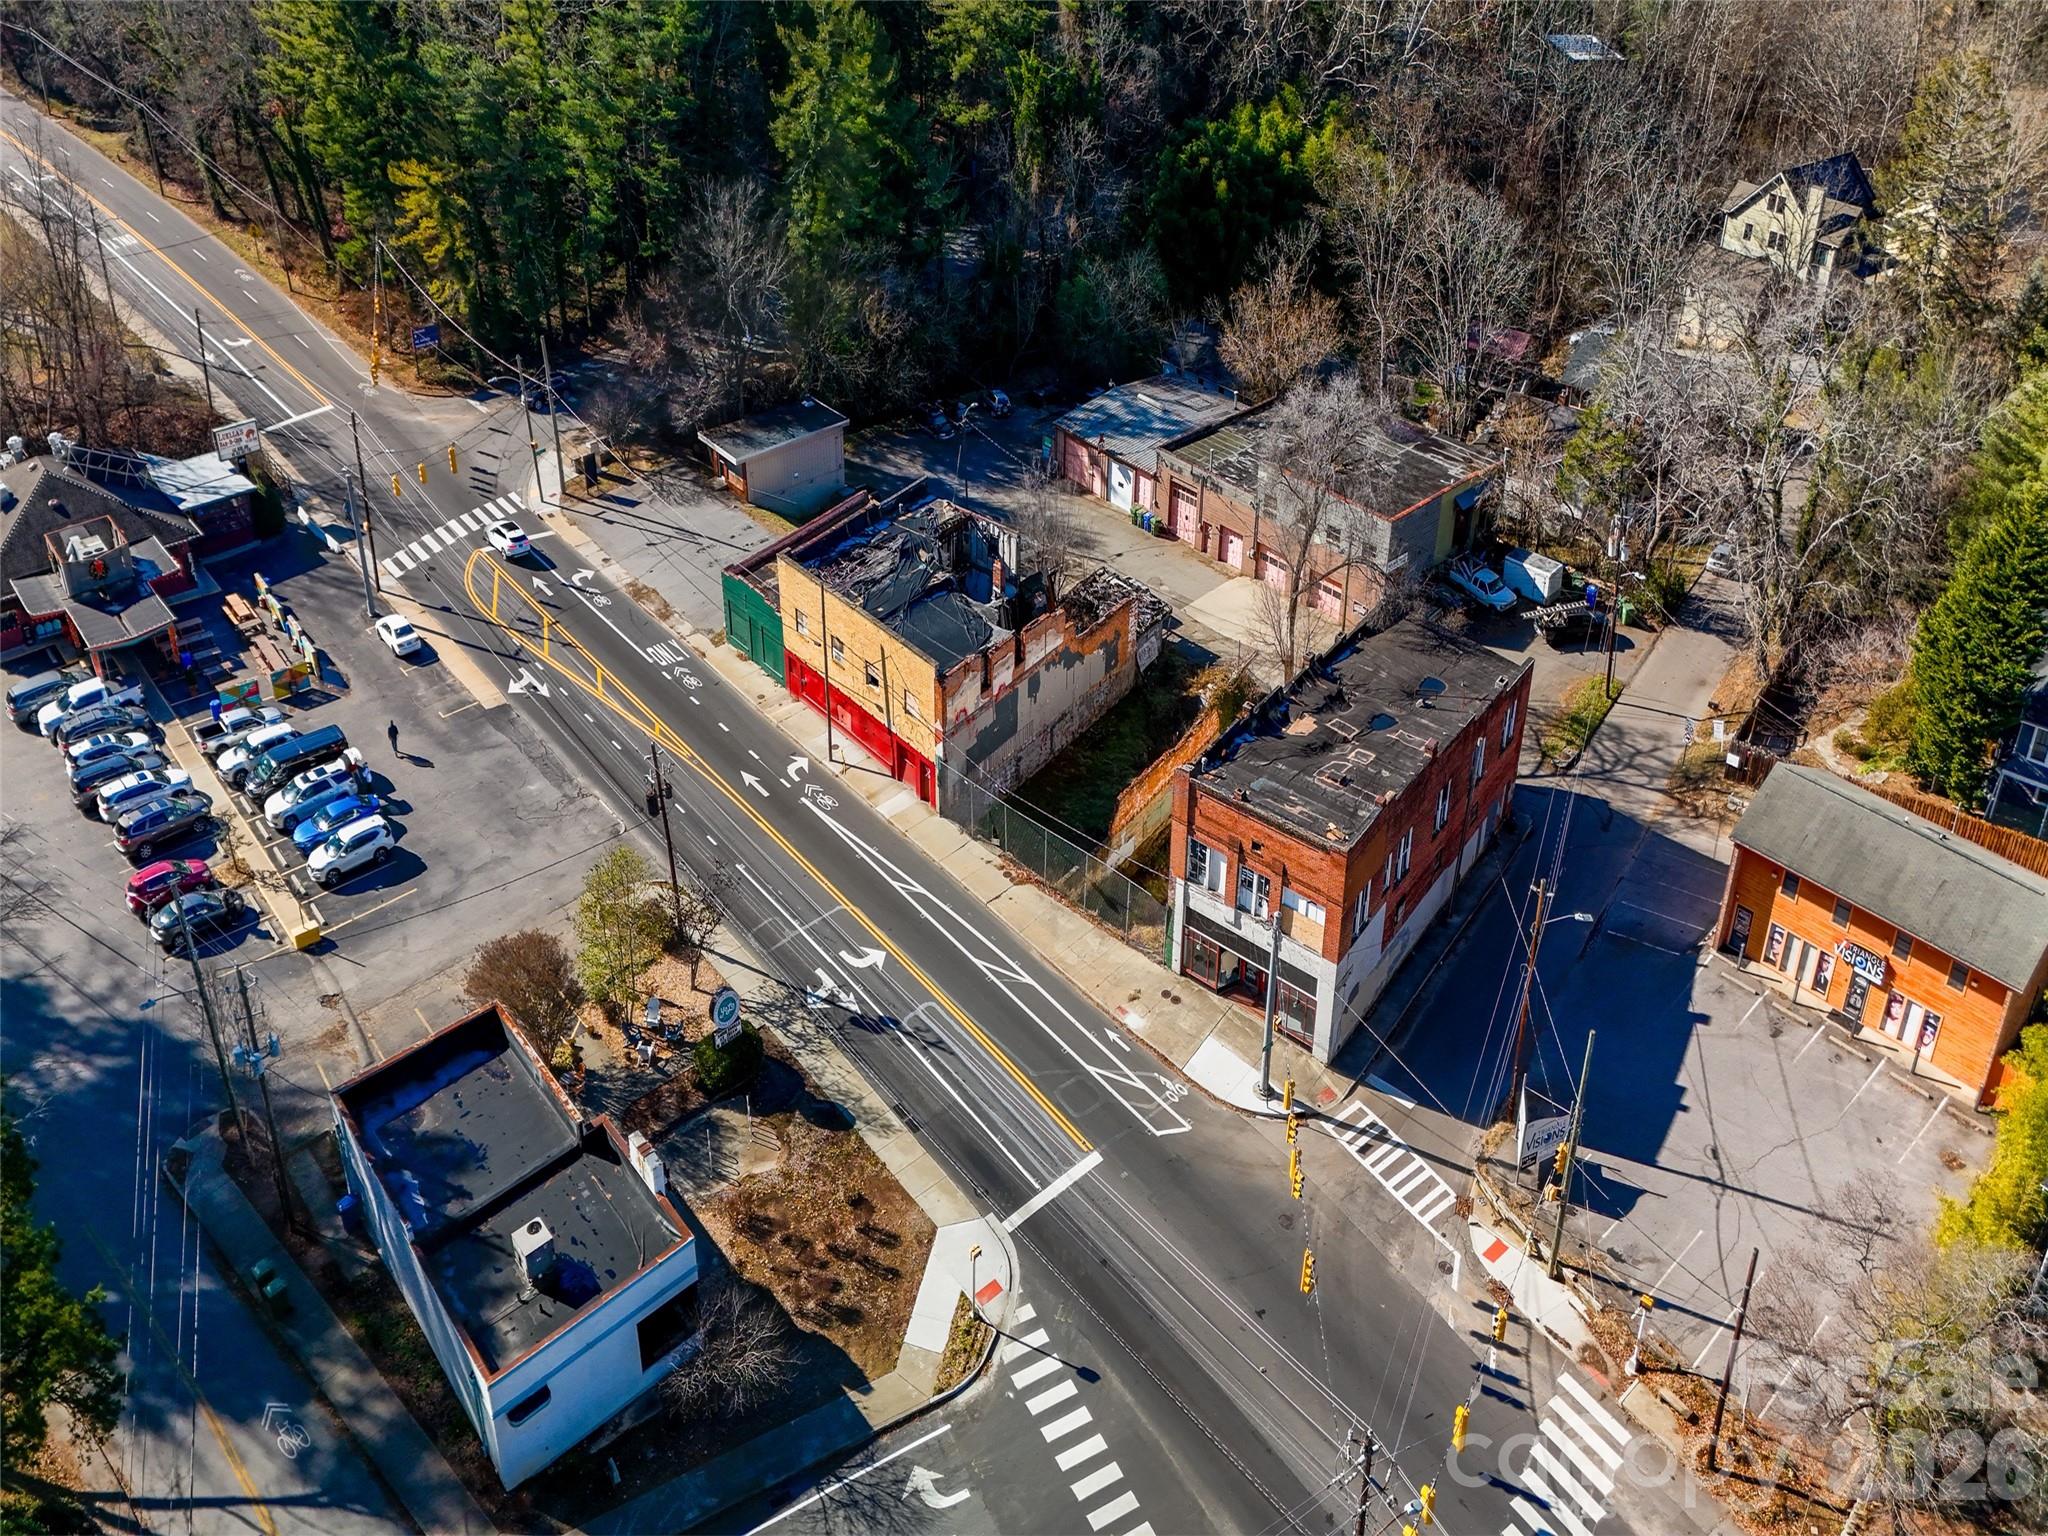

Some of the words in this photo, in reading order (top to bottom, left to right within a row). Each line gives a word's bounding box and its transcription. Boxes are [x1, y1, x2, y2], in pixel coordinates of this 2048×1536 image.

[646, 639, 690, 666] ONLY
[1834, 940, 1885, 980] VISIONS
[1848, 943, 1886, 970] TRIANGLE
[1526, 1126, 1566, 1152] VISIONS
